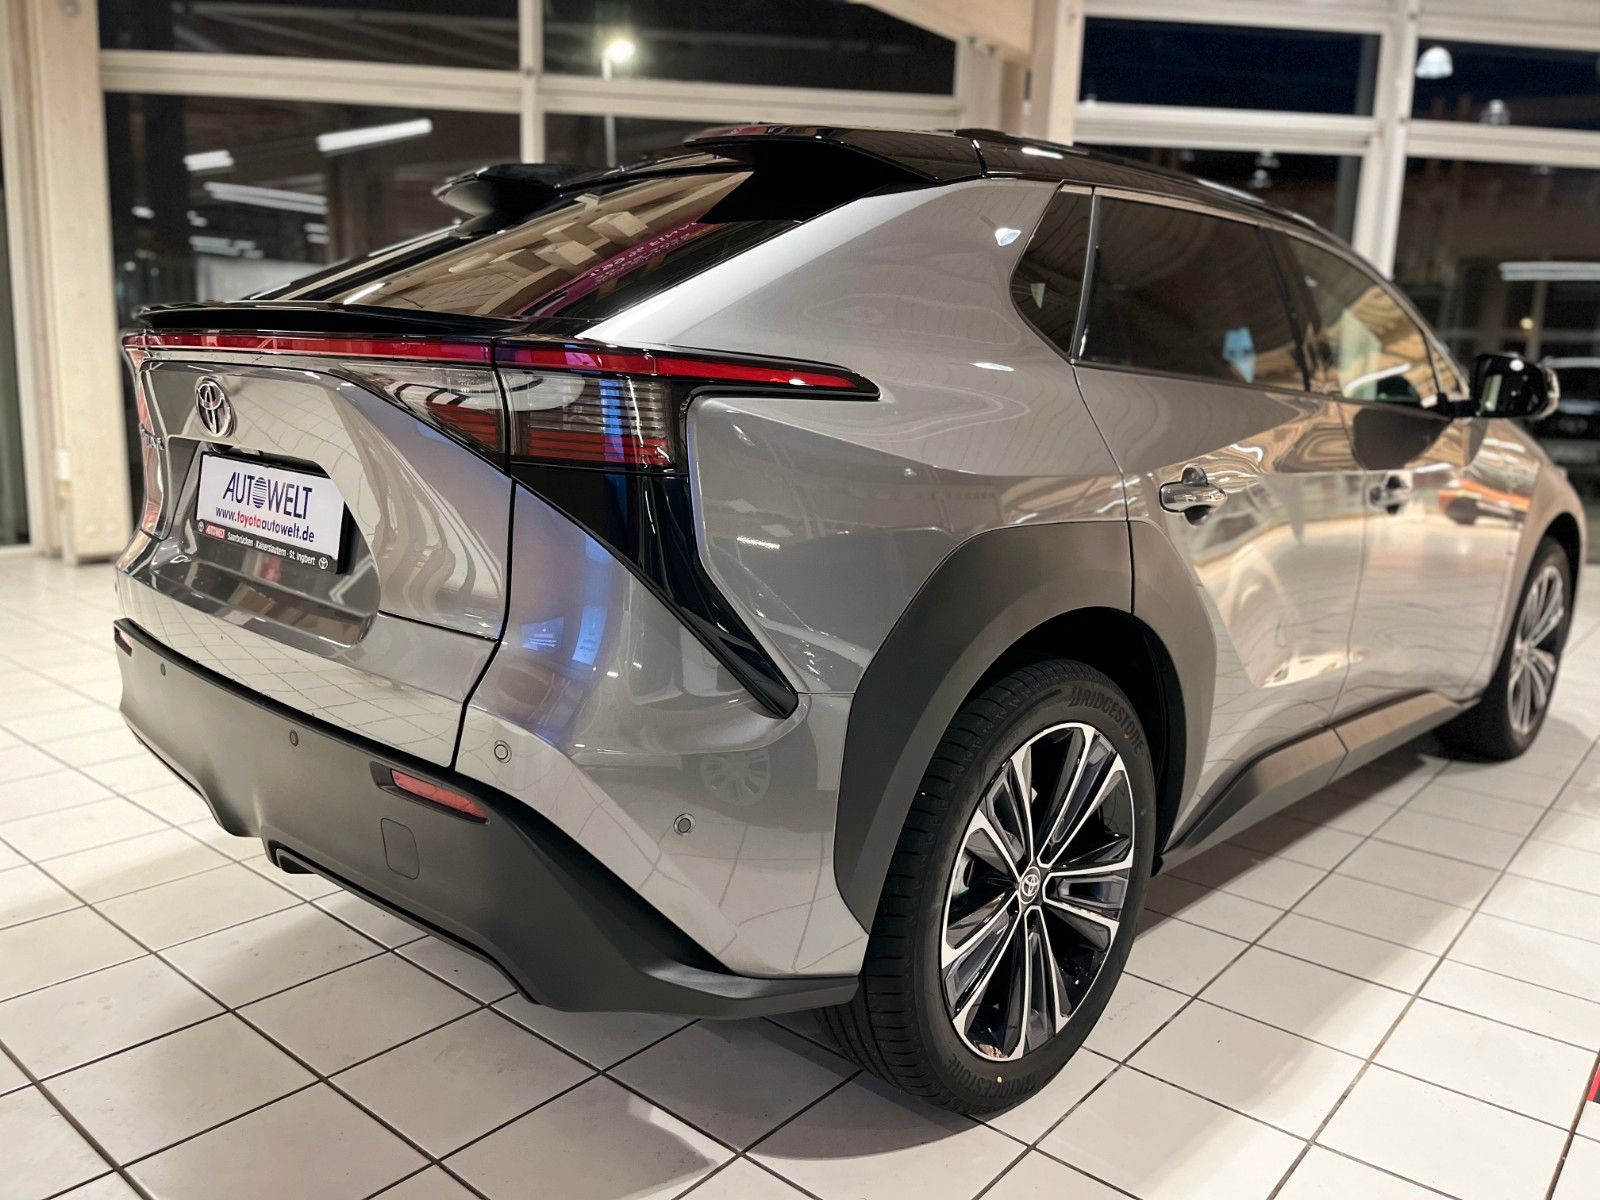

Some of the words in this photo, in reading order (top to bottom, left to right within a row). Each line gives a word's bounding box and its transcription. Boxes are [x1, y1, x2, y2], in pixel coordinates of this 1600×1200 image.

[222, 471, 313, 520] AUTOWELT
[215, 506, 315, 543] www.toyotaautowelt.de
[296, 552, 316, 566] Ingbert
[1067, 686, 1145, 755] BRIDGESTONE
